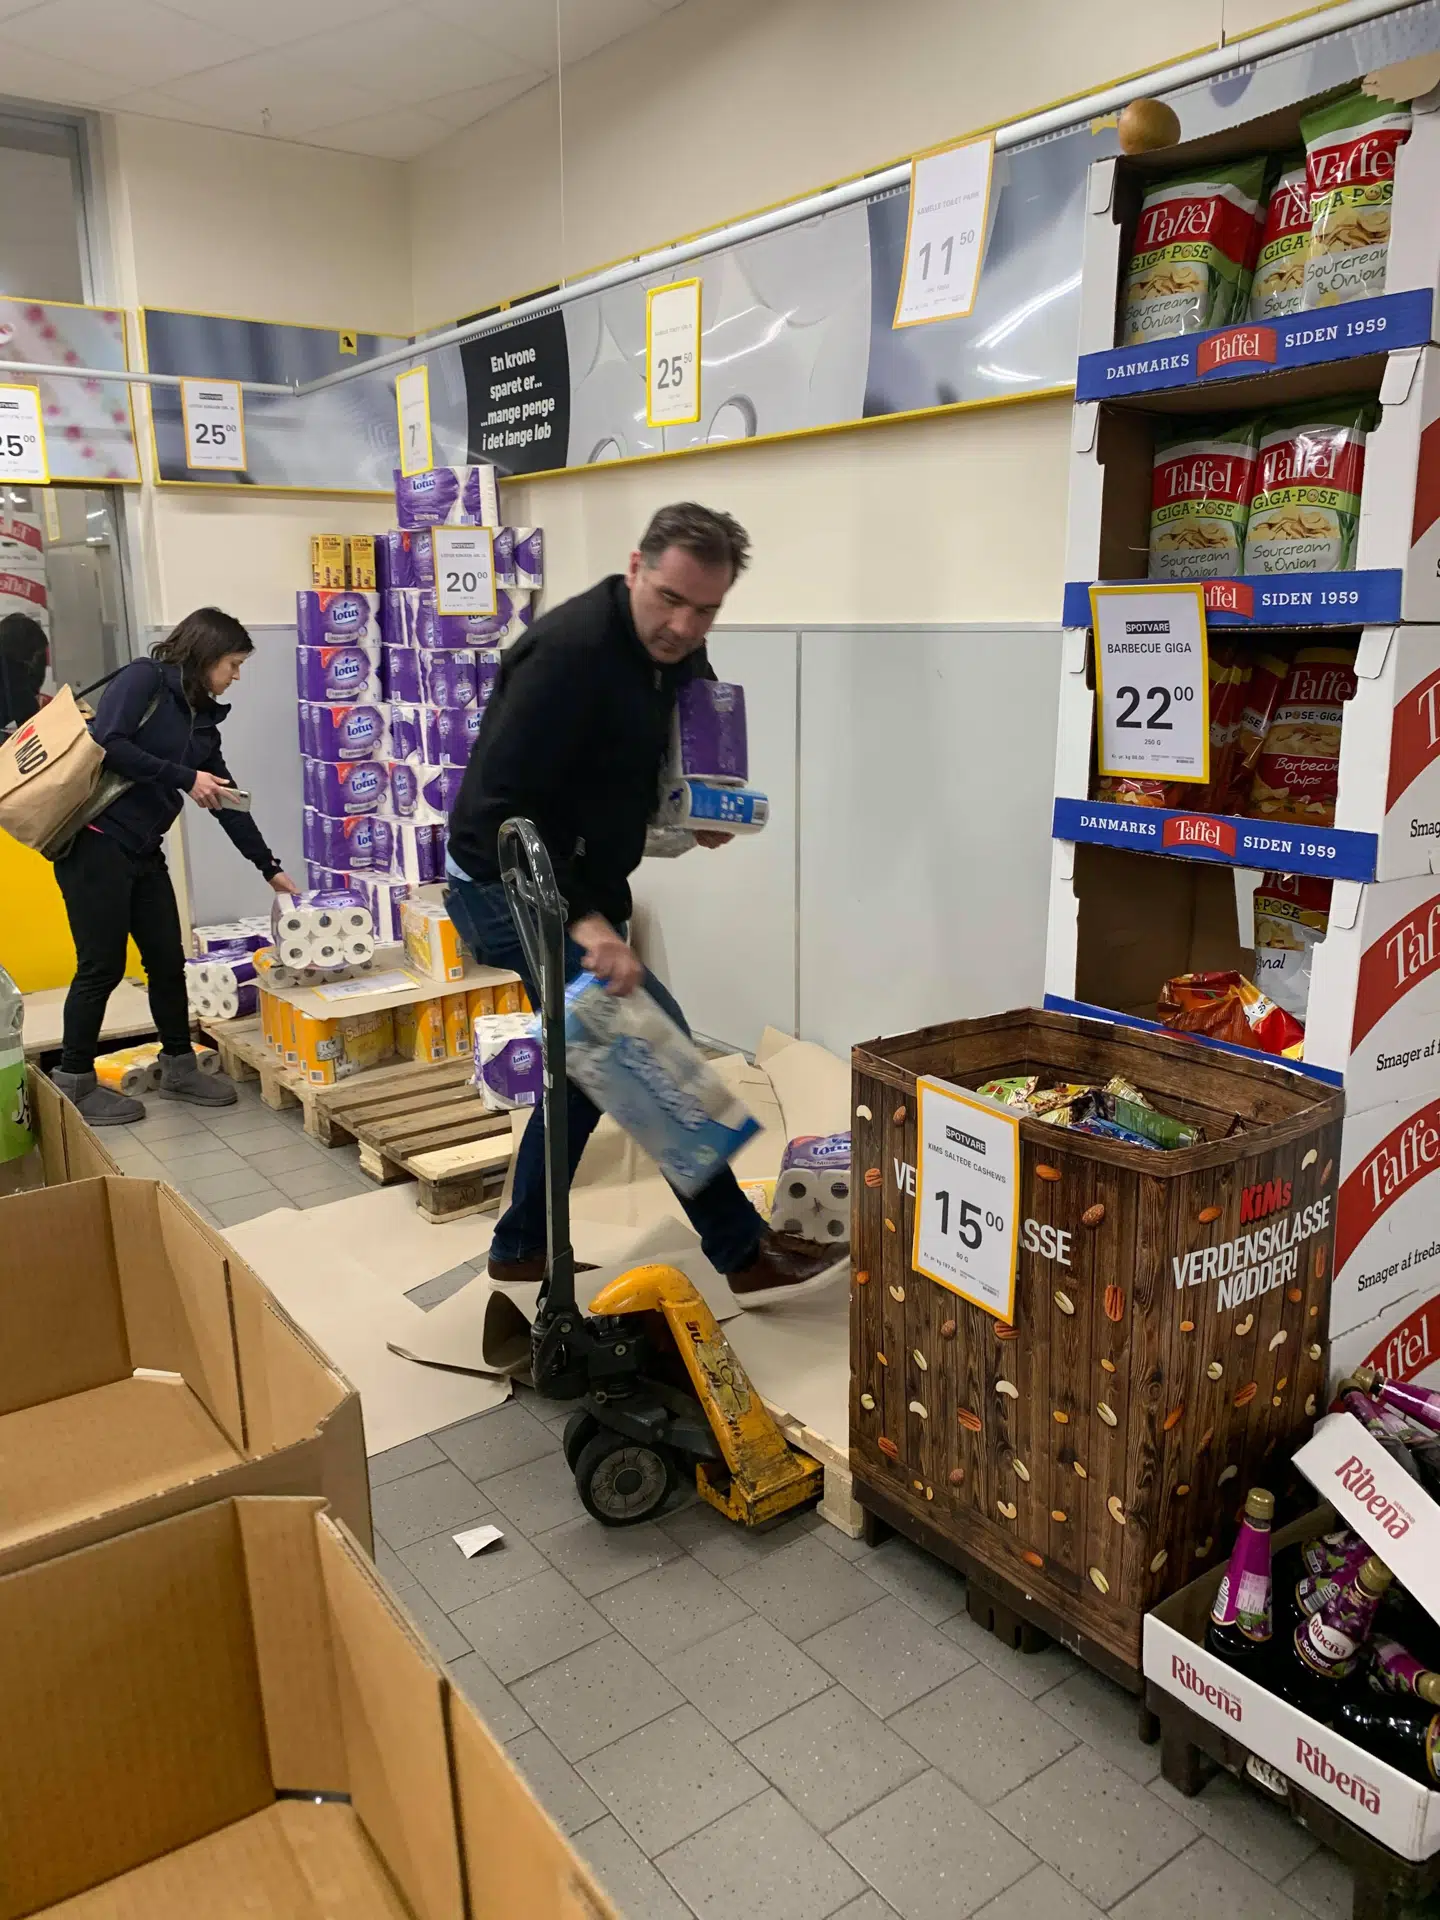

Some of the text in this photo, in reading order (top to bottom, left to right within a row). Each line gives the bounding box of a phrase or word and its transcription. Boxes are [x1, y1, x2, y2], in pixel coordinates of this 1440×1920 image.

[1312, 138, 1397, 188] Taffe
[1143, 200, 1217, 245] Taffel
[1317, 265, 1387, 295] & Onion
[1125, 296, 1199, 321] Sourcream
[1141, 313, 1181, 331] Onion
[490, 348, 537, 373] En krone
[1106, 317, 1387, 380] DANMARKS Taffel SIDEN 1959
[490, 377, 523, 401] sparet
[522, 397, 555, 421] penge
[482, 421, 552, 451] i det lange løb
[1164, 460, 1233, 498] Taffel
[1263, 449, 1338, 484] Taffel
[412, 478, 436, 491] lotus
[1160, 550, 1230, 569] Sourcream
[1252, 540, 1331, 561] Sourcream
[1264, 557, 1316, 573] & Onion
[1204, 586, 1358, 610] ffel SIDEN 1959
[332, 608, 359, 621] lotus
[1126, 621, 1170, 634] SPOTVARE
[1107, 642, 1192, 654] BARBECUE GIGA
[334, 663, 360, 678] lotus
[1288, 669, 1357, 702] Taffe
[346, 722, 373, 737] lotus
[468, 719, 481, 729] lot
[351, 778, 378, 792] lotus
[1284, 771, 1322, 788] Chips
[1080, 816, 1336, 859] DANMARKS Taffel SIDEN 1959
[1376, 1039, 1435, 1071] Smager af
[946, 1125, 986, 1155] SPOTVARE
[928, 1142, 1007, 1184] KIMS SALTEDE CASHEWS
[1362, 1117, 1440, 1212] Taffe
[893, 1157, 1072, 1266] VE SSE
[1172, 1194, 1332, 1290] VERDENSKLASSE
[1217, 1247, 1298, 1313] NØDDER!
[1357, 1263, 1399, 1292] Smager
[1401, 1253, 1412, 1270] af
[1367, 1313, 1432, 1384] ffel
[1335, 1455, 1410, 1540] Ribena
[1310, 1618, 1346, 1657] Ribena
[1171, 1654, 1242, 1722] Ribena
[1296, 1737, 1380, 1815] Ribena
